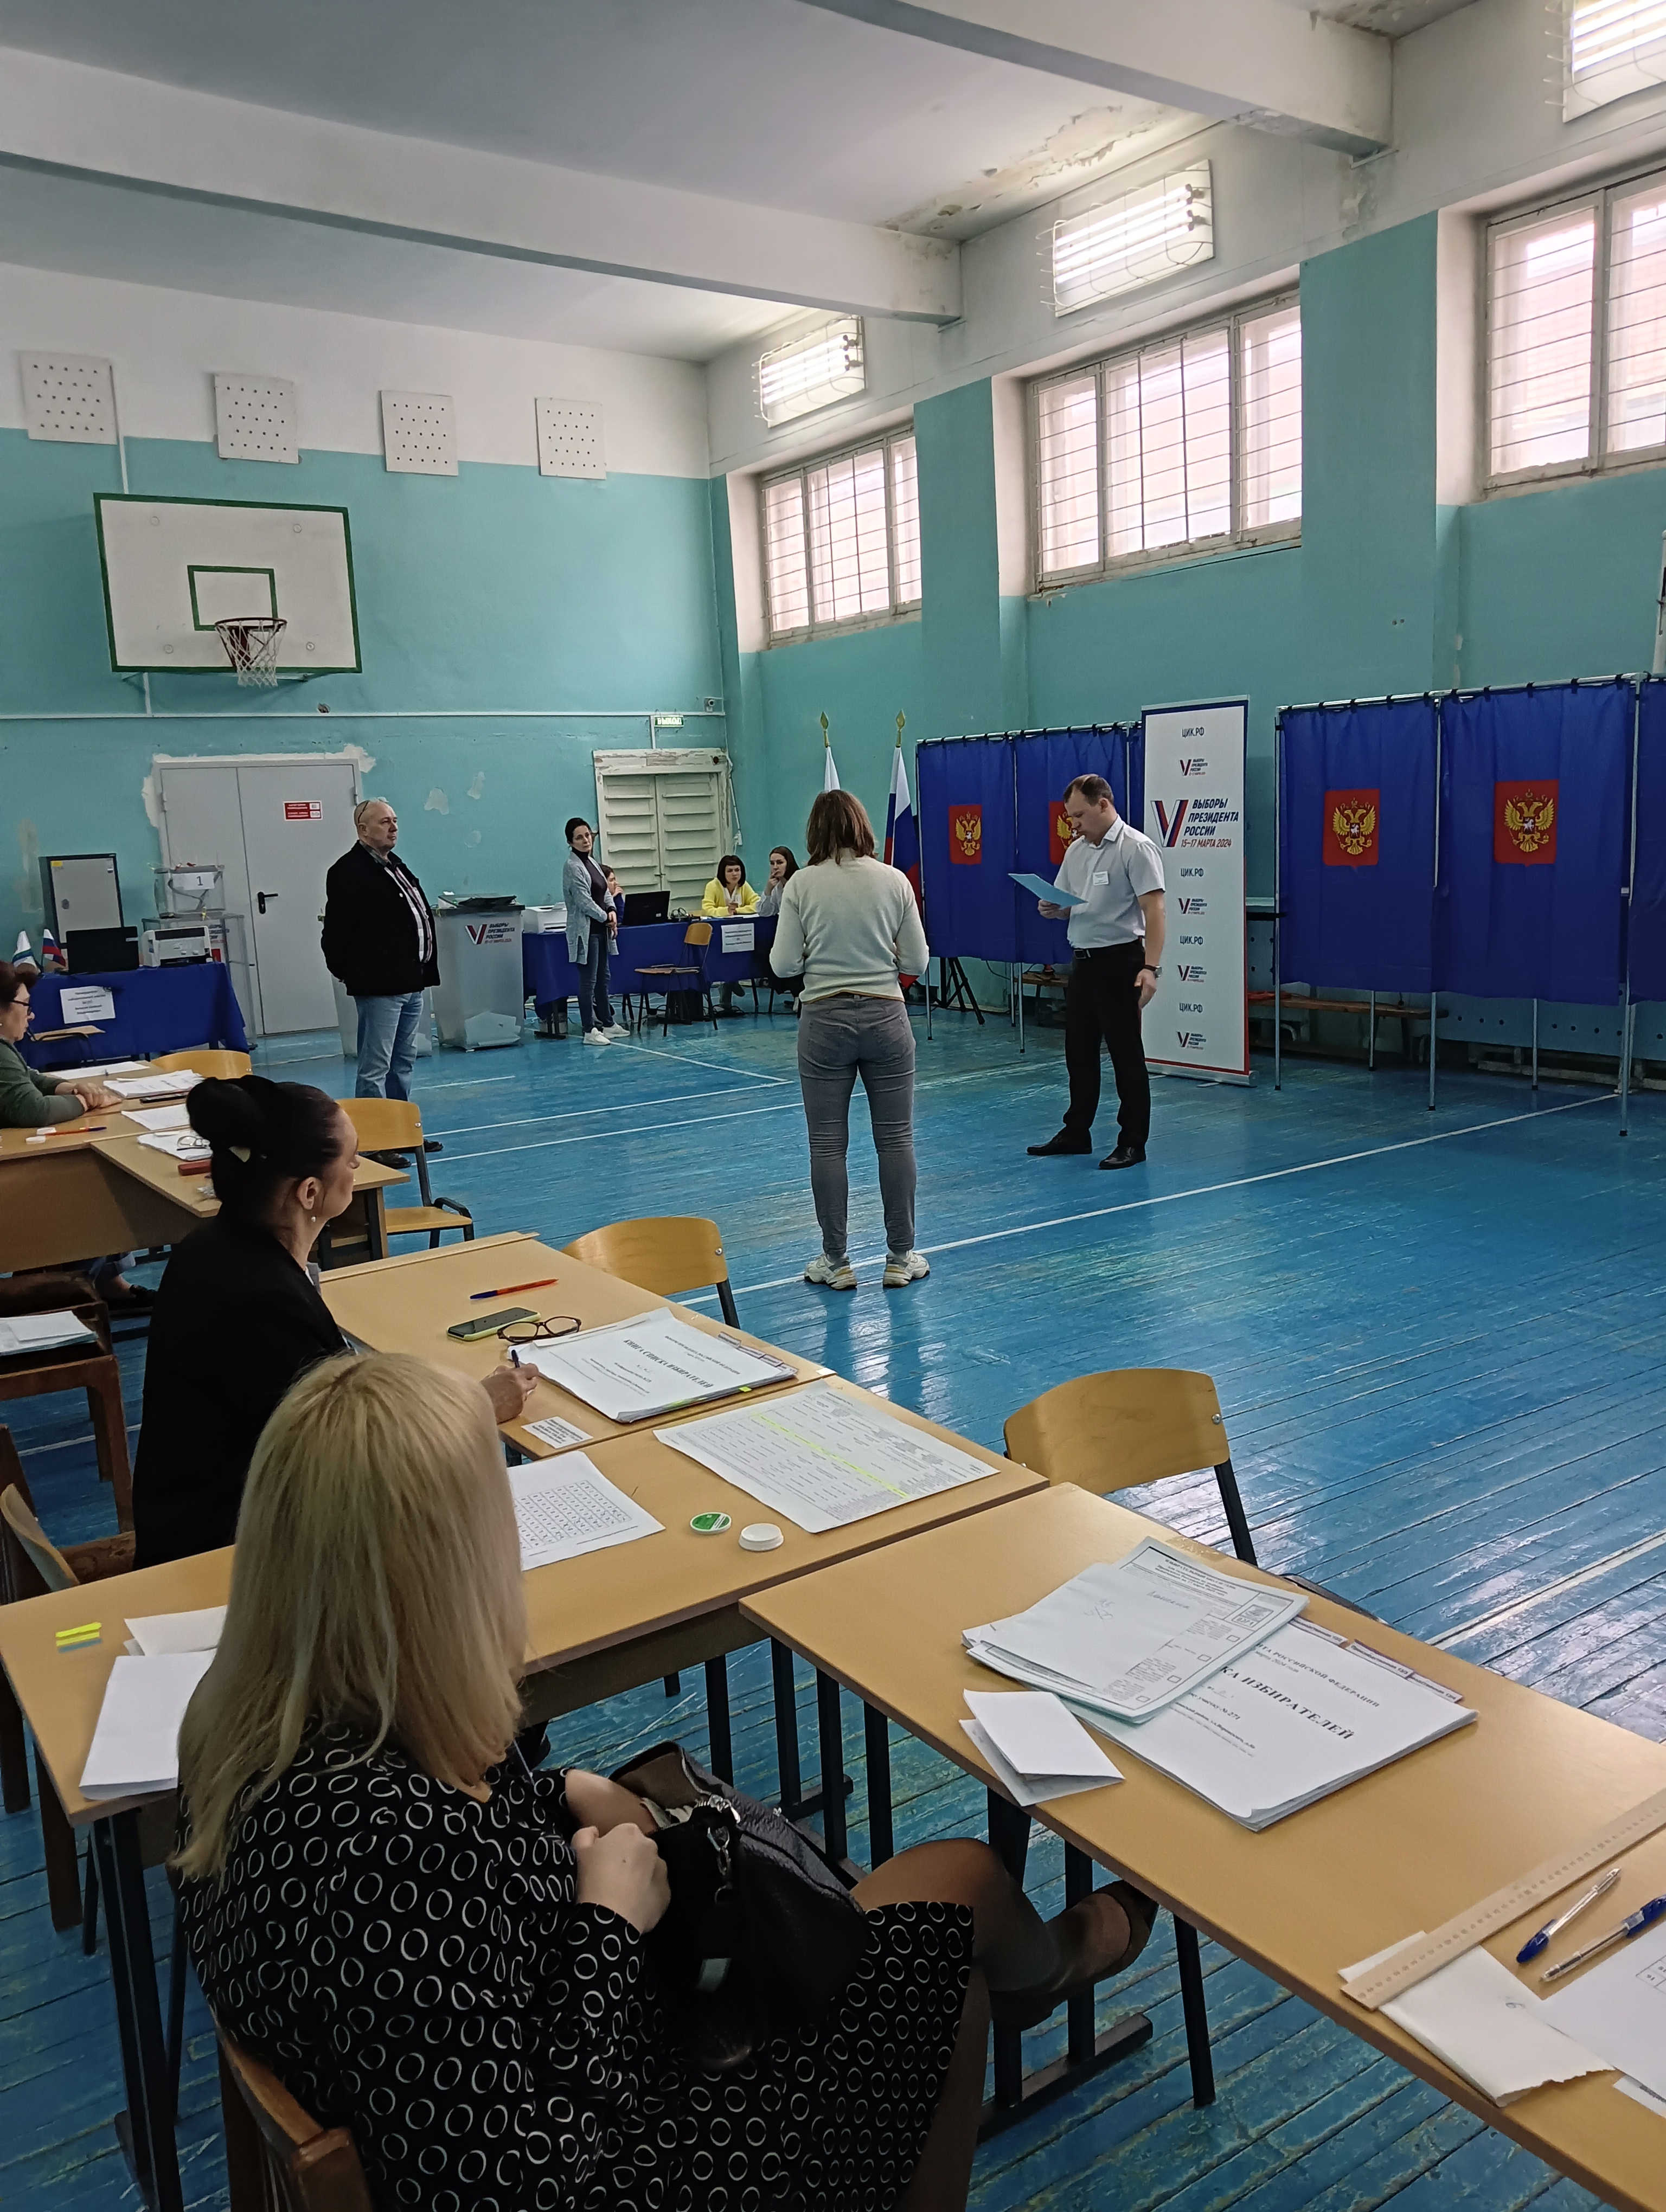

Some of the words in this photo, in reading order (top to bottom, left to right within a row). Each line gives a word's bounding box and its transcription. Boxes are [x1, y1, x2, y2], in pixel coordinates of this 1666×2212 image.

[1182, 726, 1204, 738] ЦИК.РФ
[1193, 798, 1228, 809] ВЫБОРЫ
[1188, 812, 1239, 824] ПРЕЗИДЕНТА
[1184, 826, 1216, 836] РОССИИ
[1216, 839, 1232, 847] 2024
[1181, 868, 1203, 877] ЦИК.РФ
[196, 876, 203, 886] 1
[1180, 936, 1203, 945] ЦИК.РФ
[1180, 1002, 1203, 1013] ЦИК.РФ
[1328, 1678, 1380, 1708] ФЕДЕРАЦИИ
[1241, 1676, 1356, 1739] ИЗБИРАТЕЛЕЙ
